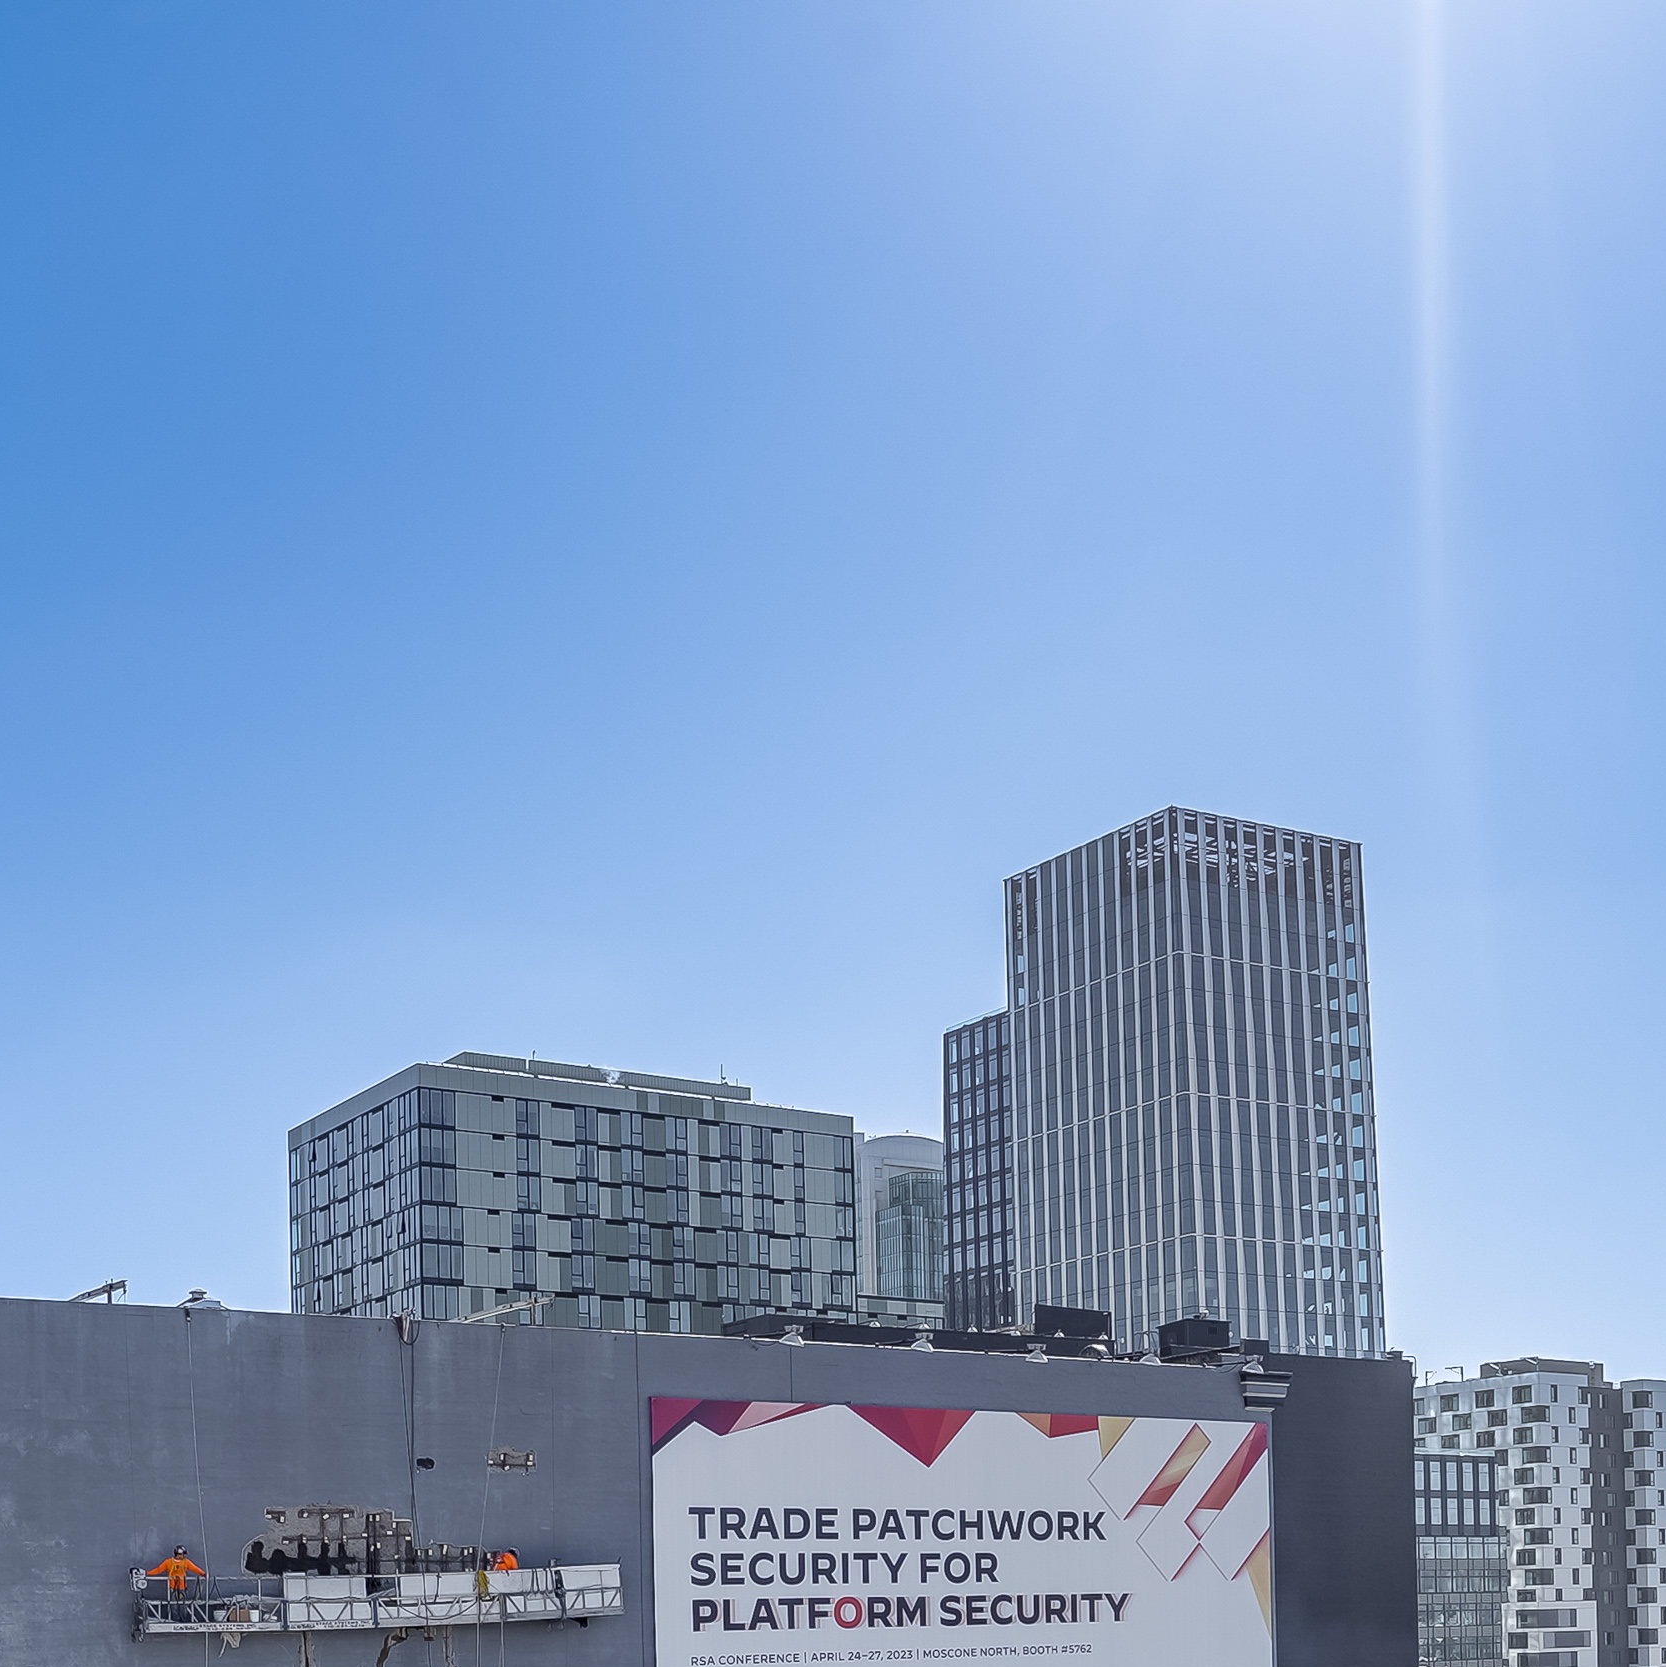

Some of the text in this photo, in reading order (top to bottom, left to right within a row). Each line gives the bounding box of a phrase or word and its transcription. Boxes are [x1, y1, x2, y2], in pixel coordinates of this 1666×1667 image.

[688, 1507, 1108, 1541] TRADE PATCHWORK
[690, 1552, 999, 1586] SECURITY FOR
[691, 1593, 1131, 1632] PLATFORM SECURITY
[691, 1656, 715, 1666] RSA
[718, 1653, 800, 1665] CONFERENCE
[811, 1651, 845, 1662] APRIL
[886, 1650, 913, 1660] 2023
[923, 1648, 977, 1659] MOSCONE
[980, 1646, 1020, 1657] NORTH,
[1023, 1645, 1058, 1655] BOOTH
[1061, 1644, 1092, 1654] #5762
